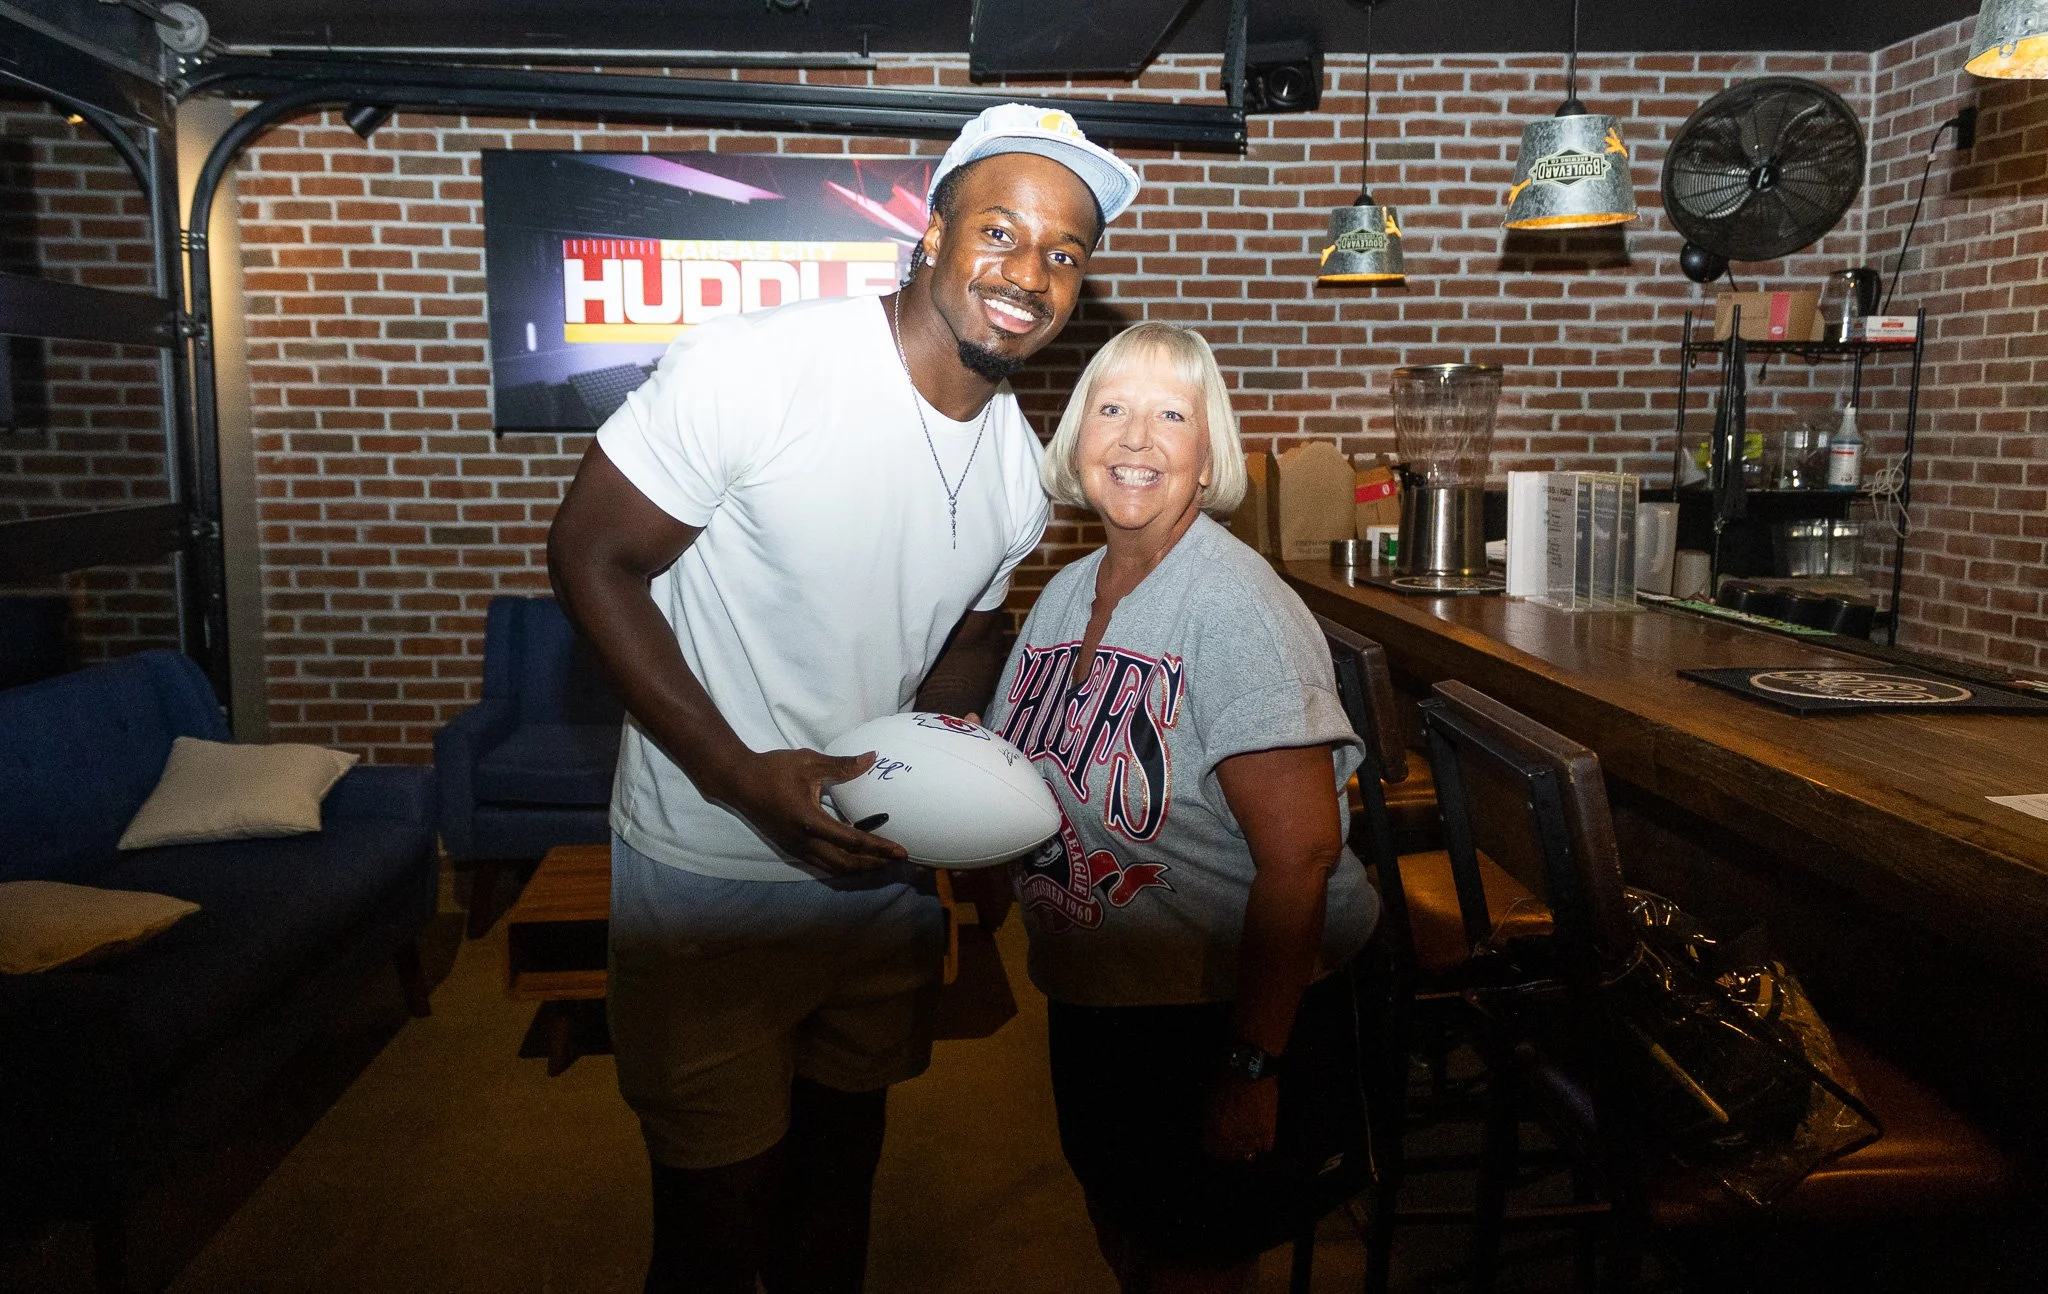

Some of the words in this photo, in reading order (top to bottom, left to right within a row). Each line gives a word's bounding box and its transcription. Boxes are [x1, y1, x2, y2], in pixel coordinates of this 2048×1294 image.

[1538, 158, 1601, 179] BOULEVARD
[663, 242, 773, 259] KANSAS
[780, 242, 834, 260] CITY
[1341, 236, 1383, 249] BOULEVARD
[1004, 640, 1184, 844] HIEFS
[1062, 825, 1088, 897] LEAGUE
[1066, 898, 1092, 922] 1960
